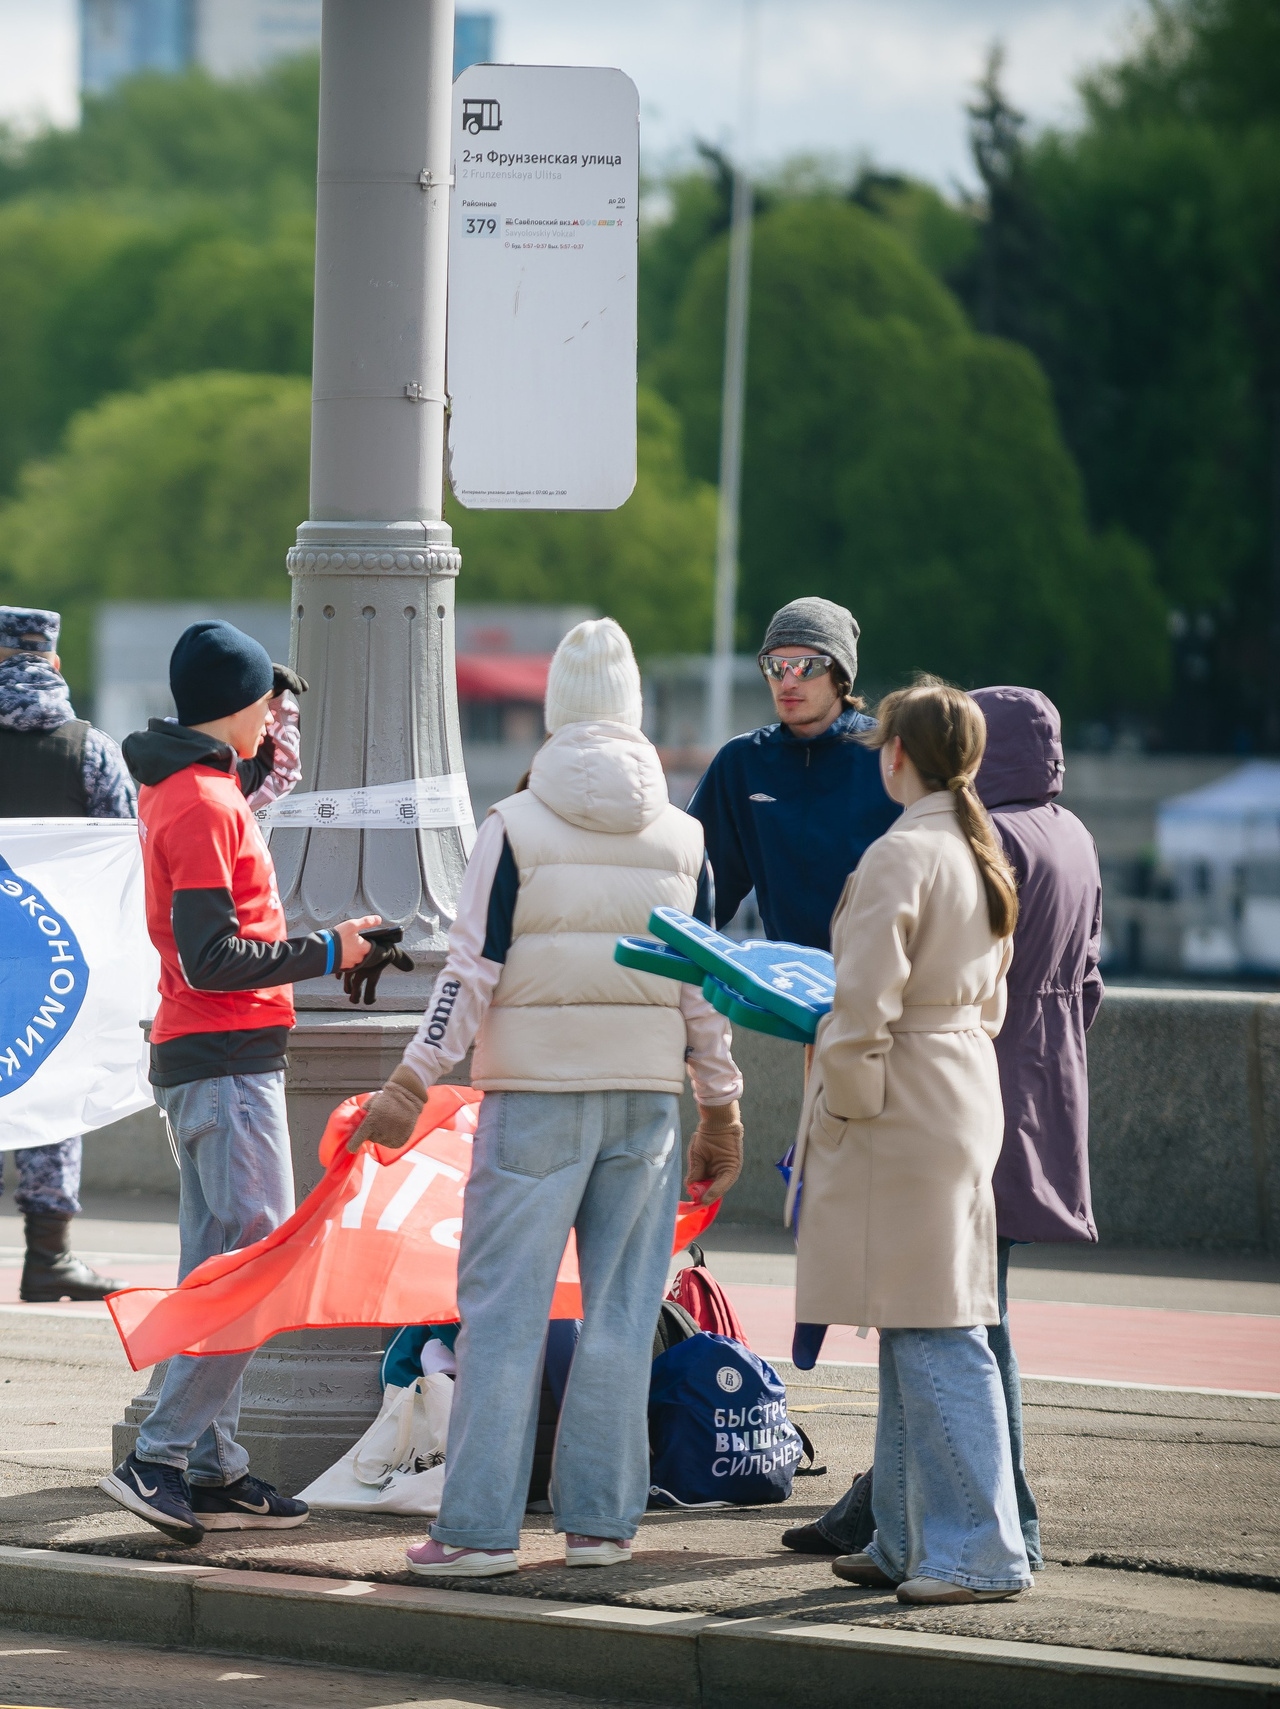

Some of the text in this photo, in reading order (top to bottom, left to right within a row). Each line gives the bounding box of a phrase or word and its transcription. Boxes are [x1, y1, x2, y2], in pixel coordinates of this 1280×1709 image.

[463, 149, 622, 168] 2-я Фрунзенская улица
[462, 169, 562, 181] 2 Frunzenskaya Ulitsa
[462, 200, 497, 208] Районные
[466, 218, 497, 234] 379
[514, 218, 558, 226] Савёловский
[505, 229, 576, 238] Savyolovskiy Vokzal
[714, 1398, 787, 1428] БЫСТРЕ
[711, 1440, 800, 1477] СИЛЬНЕЕ
